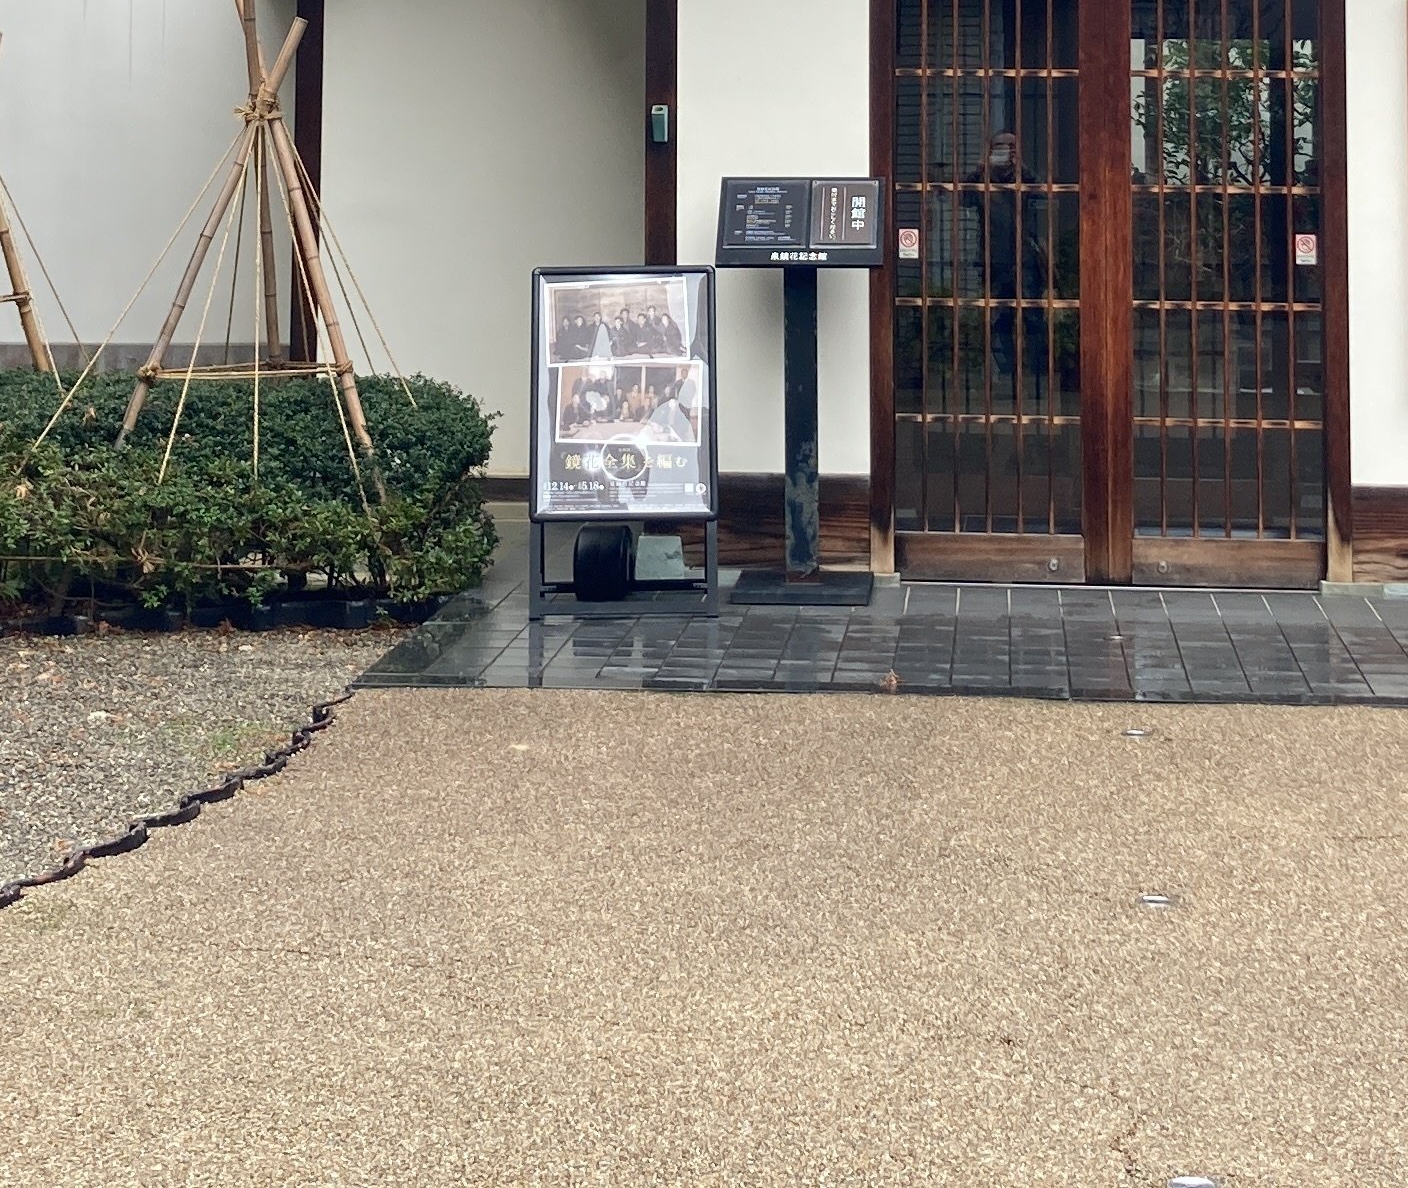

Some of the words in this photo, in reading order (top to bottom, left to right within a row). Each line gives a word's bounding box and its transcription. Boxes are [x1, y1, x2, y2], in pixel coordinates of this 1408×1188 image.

[851, 196, 866, 230] 開館中
[770, 252, 828, 261] 泉鏡花記念館
